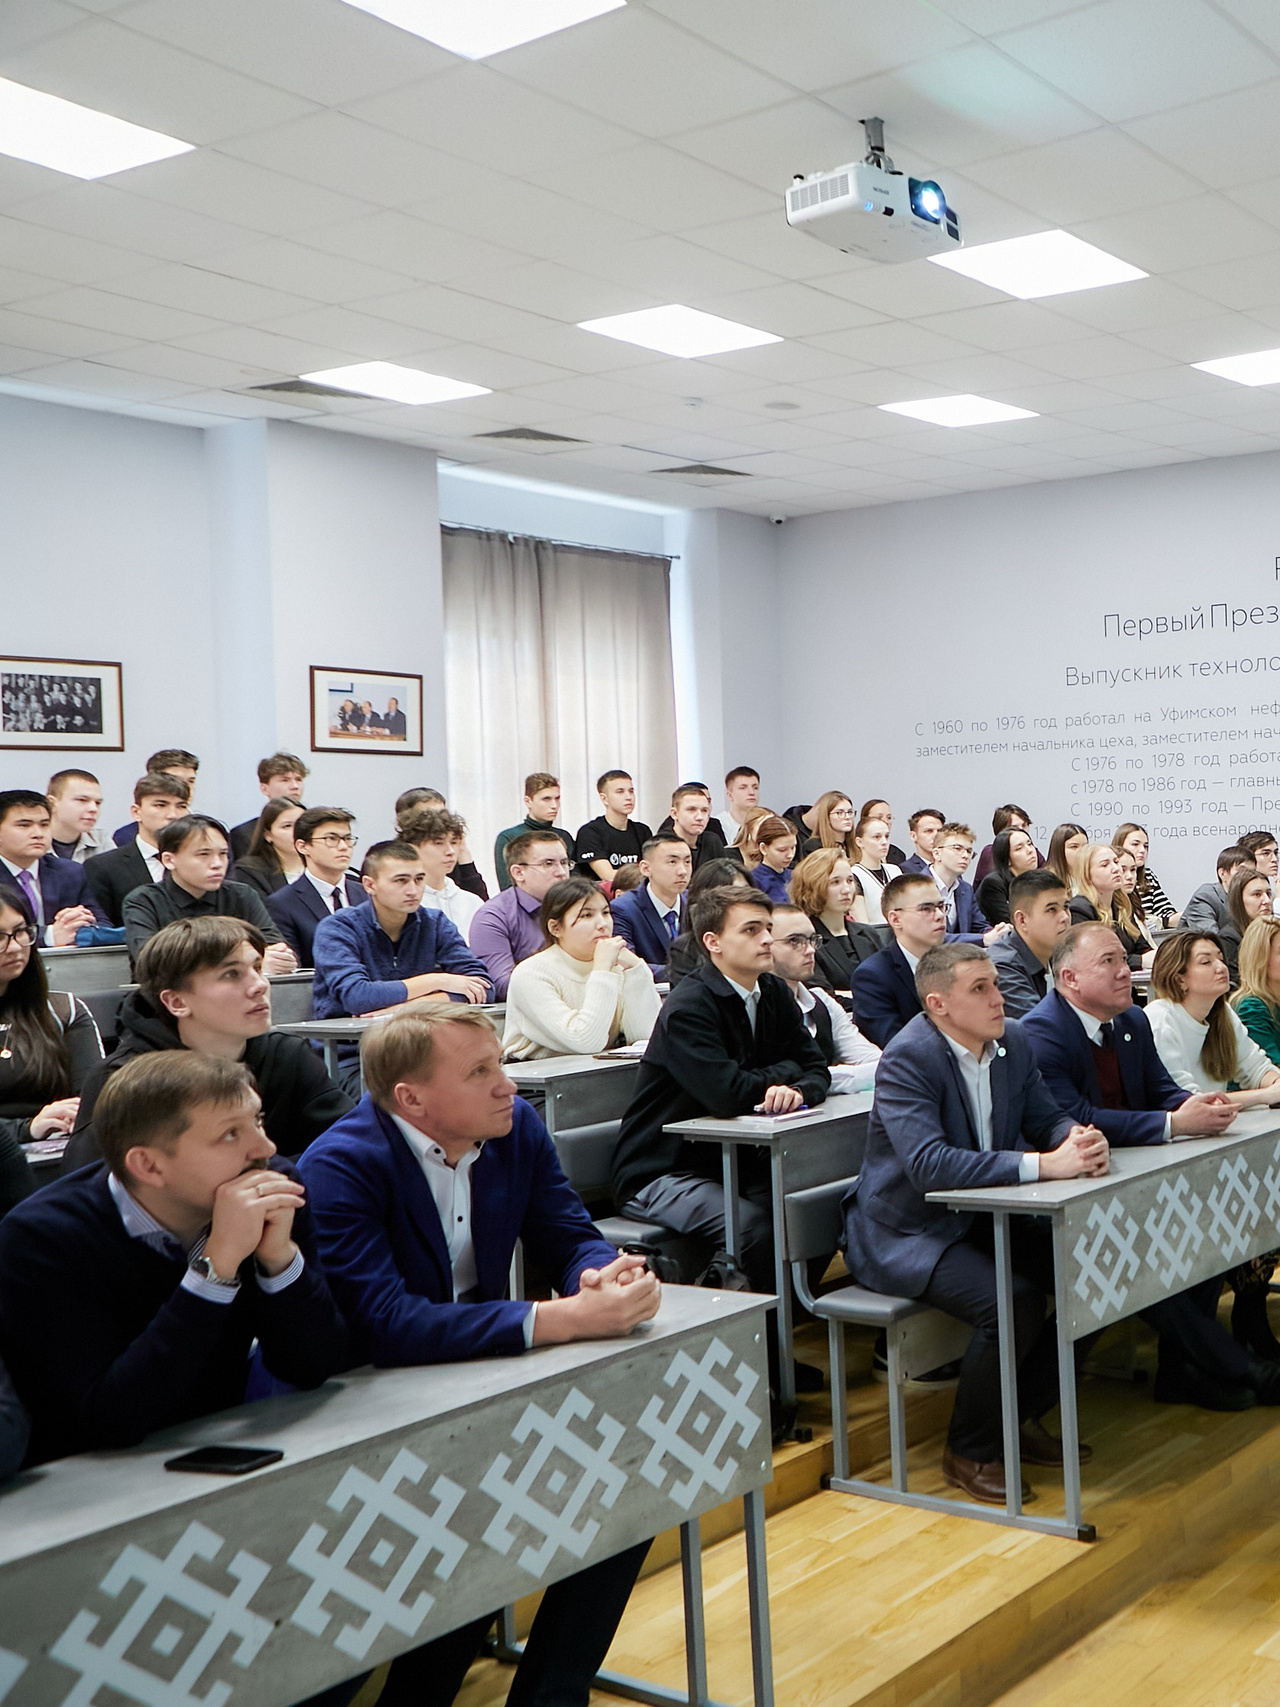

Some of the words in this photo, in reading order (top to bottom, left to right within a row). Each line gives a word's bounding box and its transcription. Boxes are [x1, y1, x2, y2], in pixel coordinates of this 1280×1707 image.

[1103, 605, 1205, 642] Первый
[1065, 663, 1183, 689] Выпускник
[914, 722, 925, 737] С
[932, 719, 964, 735] 1960
[970, 721, 989, 733] по
[995, 715, 1026, 731] 1976
[1033, 717, 1058, 731] год
[1065, 711, 1126, 731] работал
[1133, 711, 1152, 724] на
[1159, 706, 1237, 724] Уфимском
[915, 742, 1009, 758] заместителем
[1012, 737, 1096, 752] начальника
[1099, 735, 1138, 750] цеха,
[1141, 729, 1249, 746] заместителем
[1071, 757, 1081, 772] С
[1084, 755, 1118, 772] 1976
[1125, 758, 1144, 770] по
[1151, 752, 1186, 769] 1978
[1193, 754, 1221, 768] год
[1070, 783, 1079, 795] с
[1081, 778, 1115, 794] 1978
[1118, 781, 1138, 793] по
[1140, 775, 1177, 792] 1986
[1180, 778, 1208, 793] год
[1070, 802, 1081, 817] С
[1087, 800, 1124, 817] 1990
[1131, 804, 1151, 816] по
[1157, 798, 1193, 815] 1993
[1201, 801, 1229, 815] год
[1153, 826, 1189, 840] года
